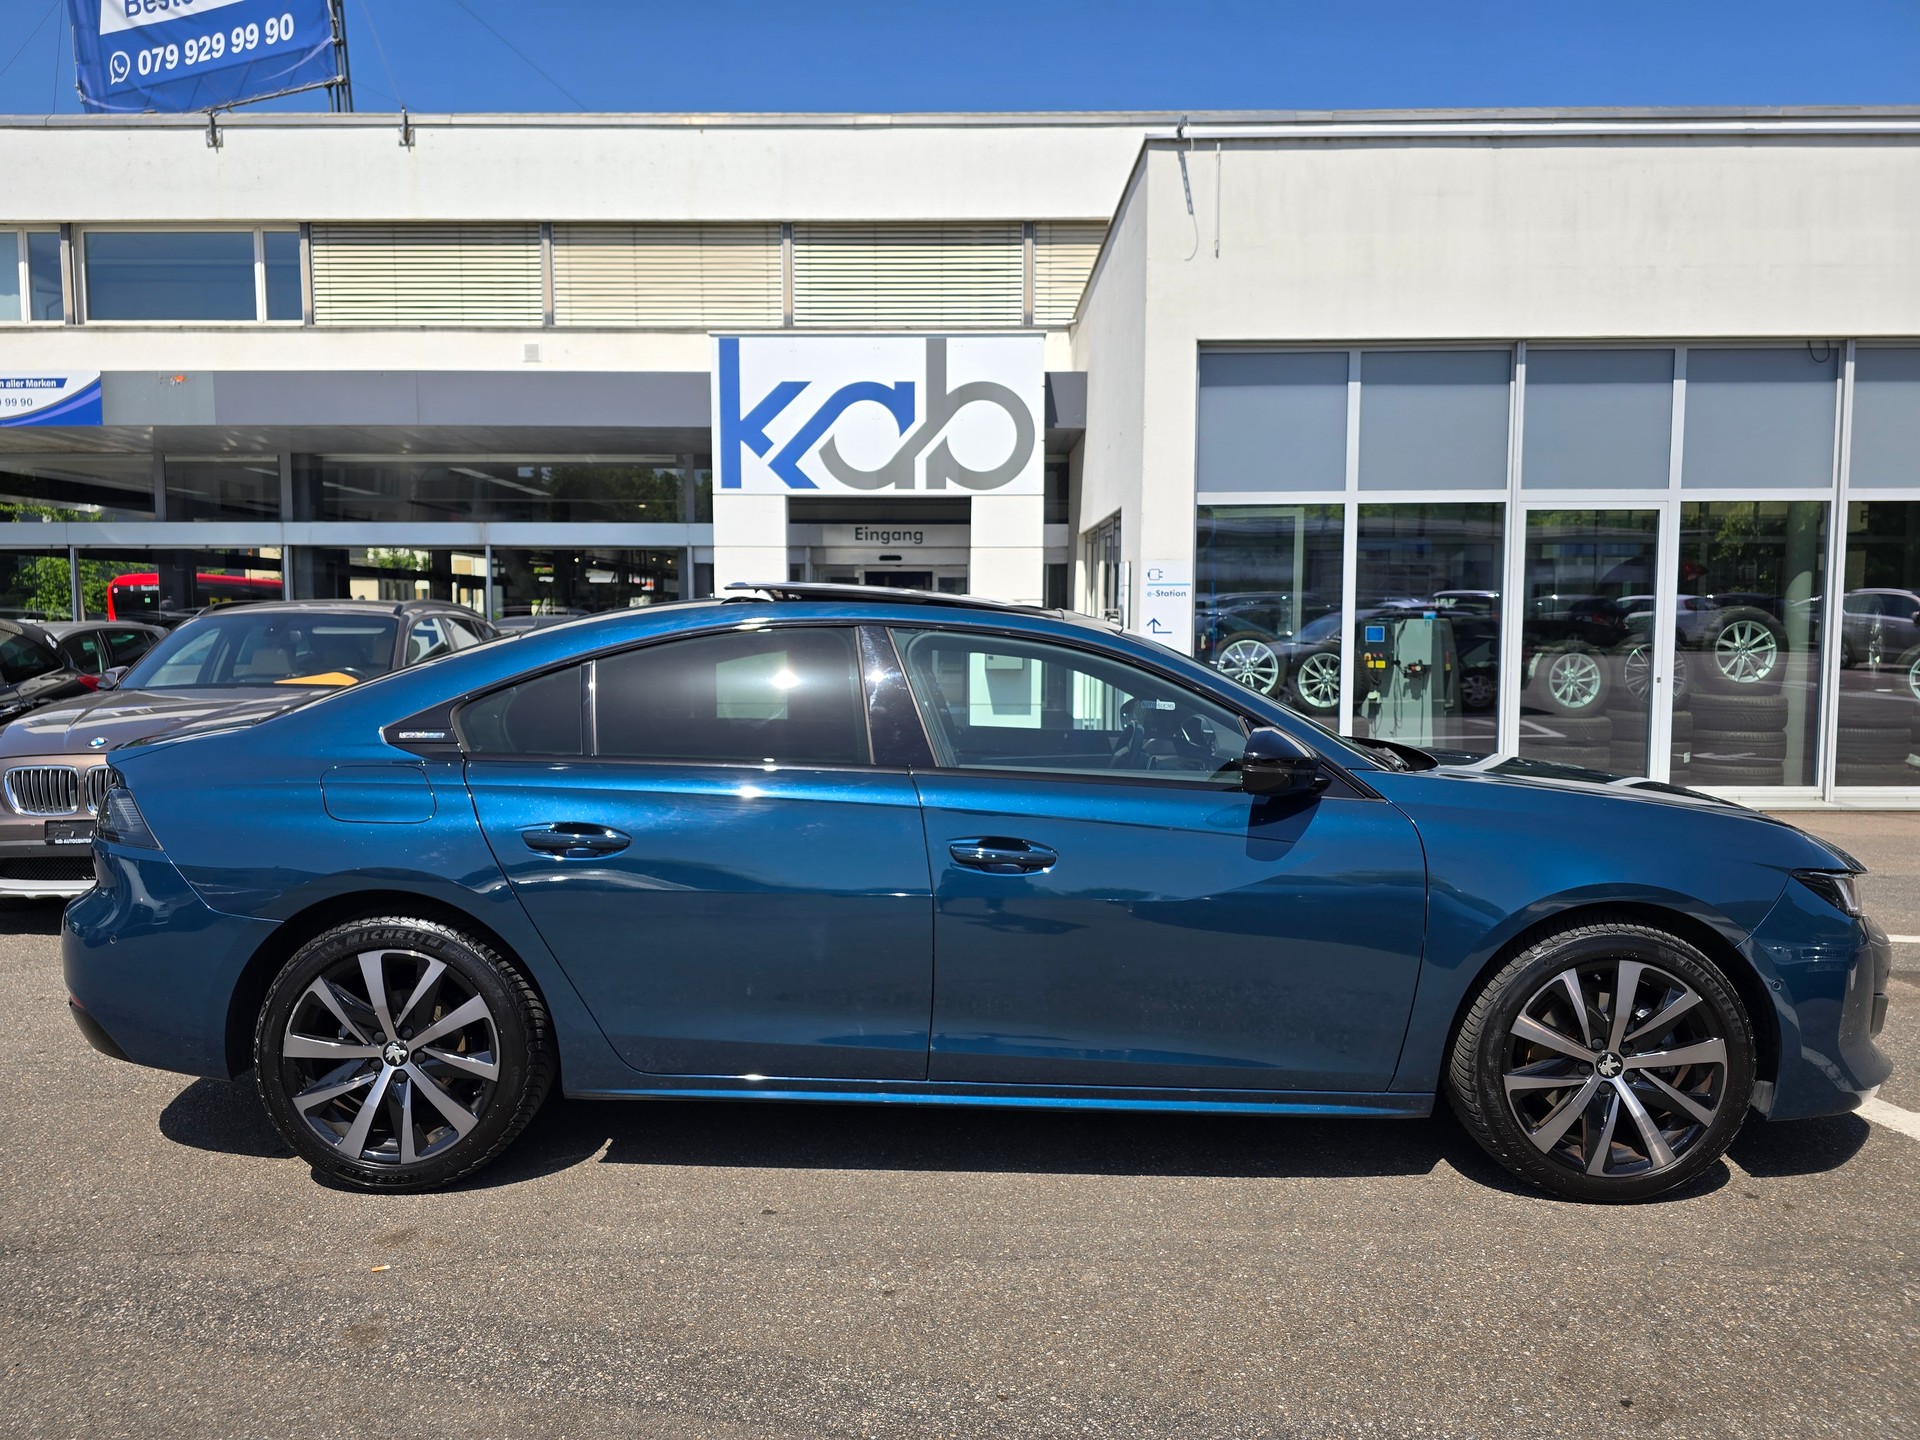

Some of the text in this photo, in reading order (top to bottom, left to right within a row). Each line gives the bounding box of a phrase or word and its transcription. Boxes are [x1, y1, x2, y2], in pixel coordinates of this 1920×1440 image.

[124, 0, 193, 18] Bes
[138, 13, 294, 75] 079 929 99 90
[6, 379, 24, 388] aller
[26, 379, 57, 388] Marken
[5, 398, 17, 407] 99
[20, 398, 33, 407] 90
[718, 338, 1036, 490] kab
[854, 526, 924, 545] Eingang
[1147, 589, 1187, 597] e-Station
[347, 929, 442, 947] MICHELIN
[1682, 961, 1745, 1039] MICHELIN
